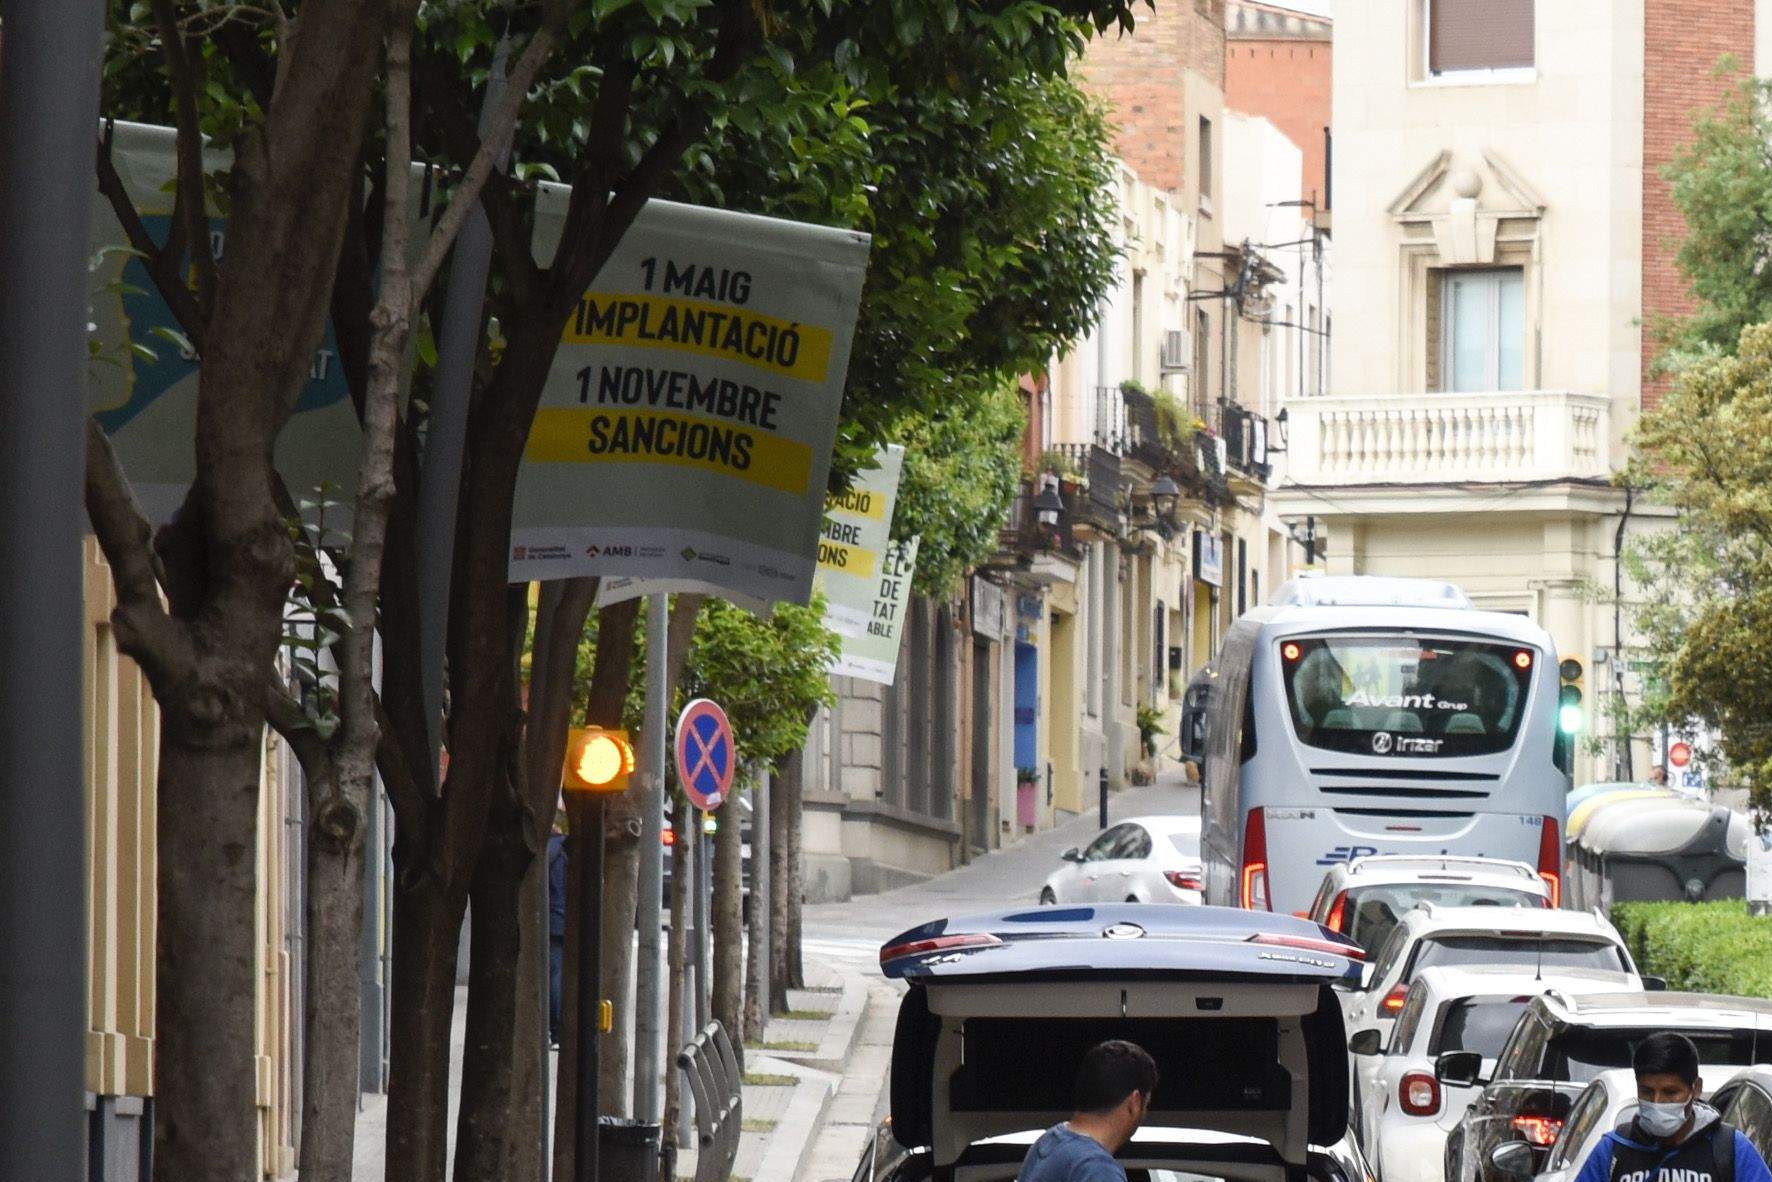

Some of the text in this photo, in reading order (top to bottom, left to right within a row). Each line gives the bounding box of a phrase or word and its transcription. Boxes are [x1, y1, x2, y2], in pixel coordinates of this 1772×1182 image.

[641, 257, 752, 305] 1 MAIG
[574, 299, 801, 367] IMPLANTACIÓ
[576, 366, 782, 431] 1 NOVEMBRE
[588, 415, 754, 471] SANCIONS
[603, 546, 632, 557] AMB
[880, 578, 902, 601] DE
[867, 621, 893, 639] ABLE
[1344, 690, 1468, 711] Avant Grup
[1396, 736, 1444, 753] irizar
[1519, 815, 1542, 826] 148
